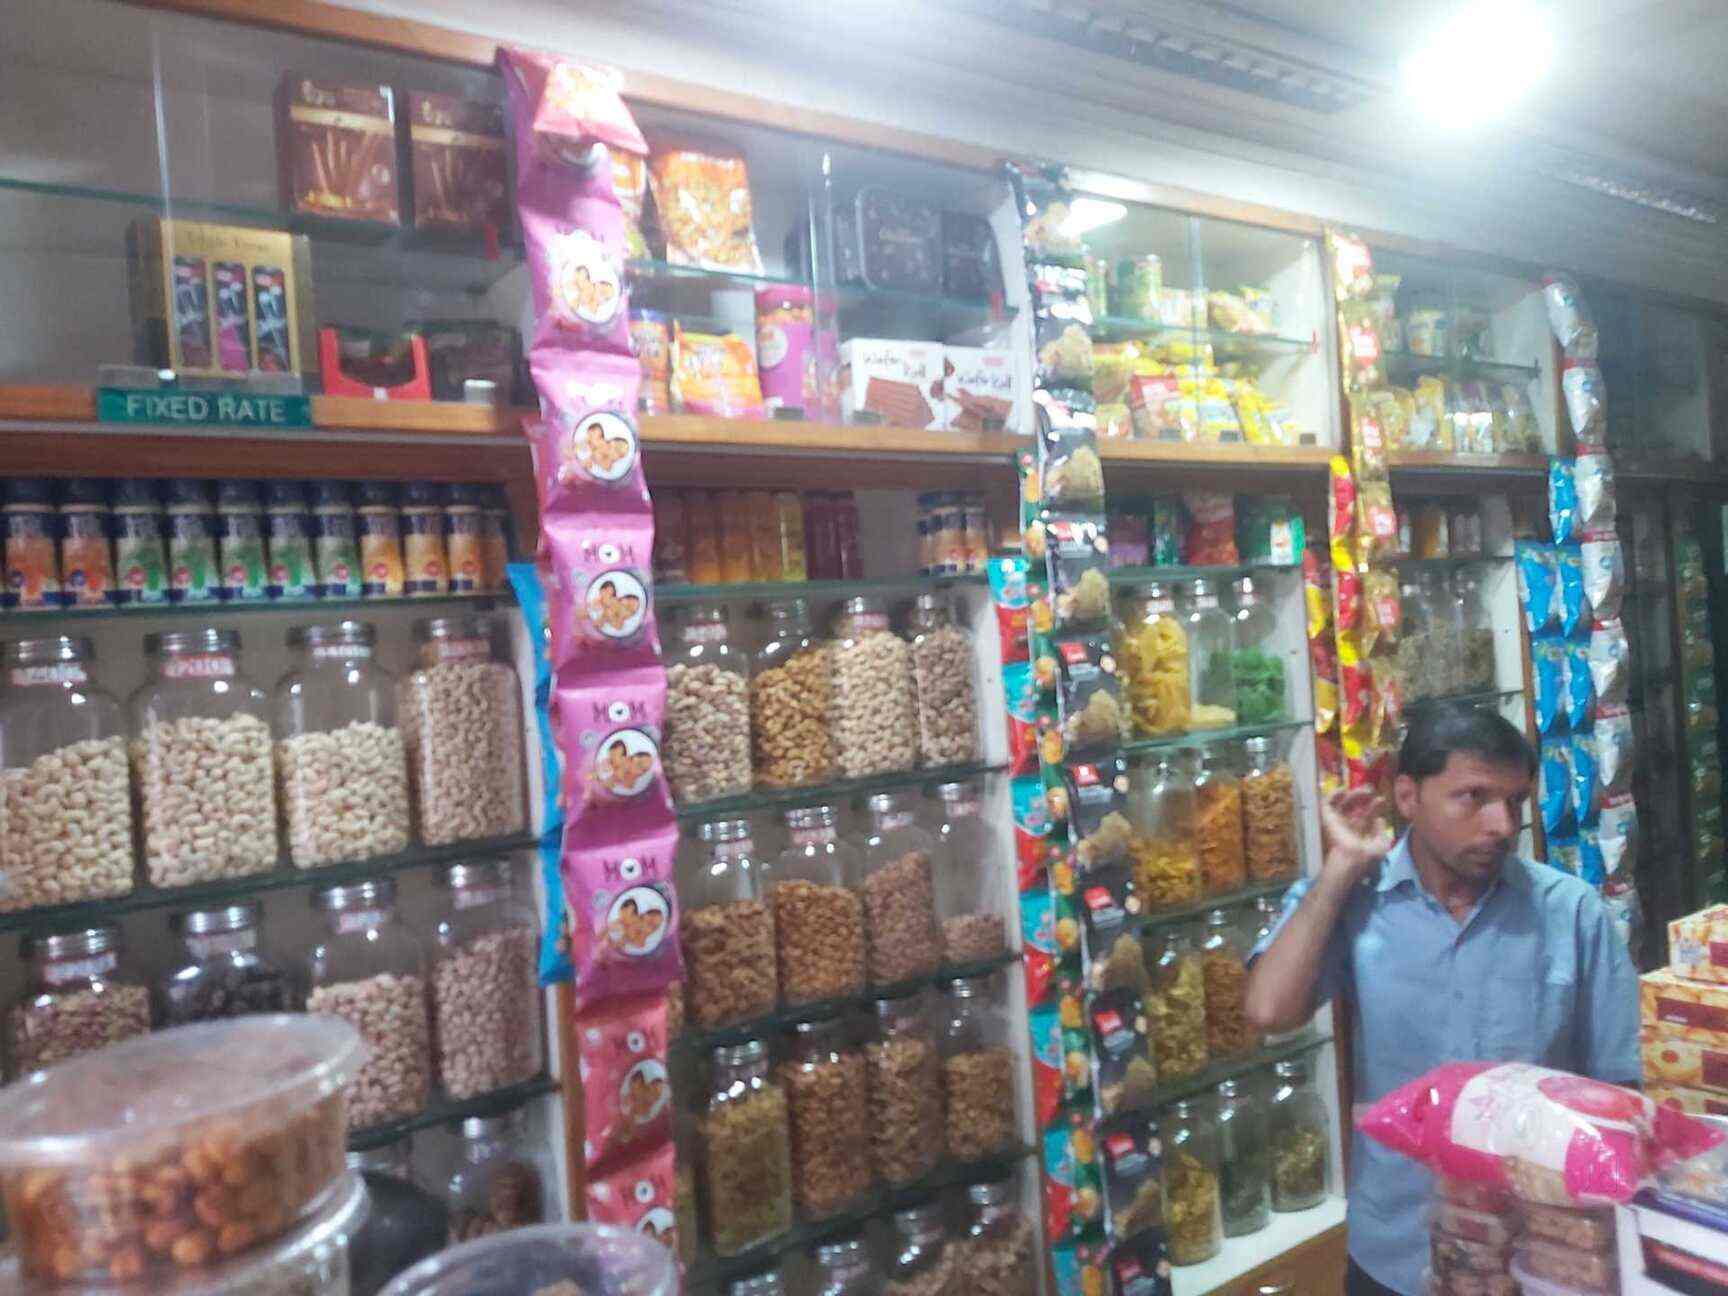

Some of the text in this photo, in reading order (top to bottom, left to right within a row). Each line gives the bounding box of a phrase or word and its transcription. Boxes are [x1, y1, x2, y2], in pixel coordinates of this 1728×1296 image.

[126, 395, 286, 422] FIXED RATE
[593, 700, 647, 724] MOM
[603, 856, 656, 882] MOM
